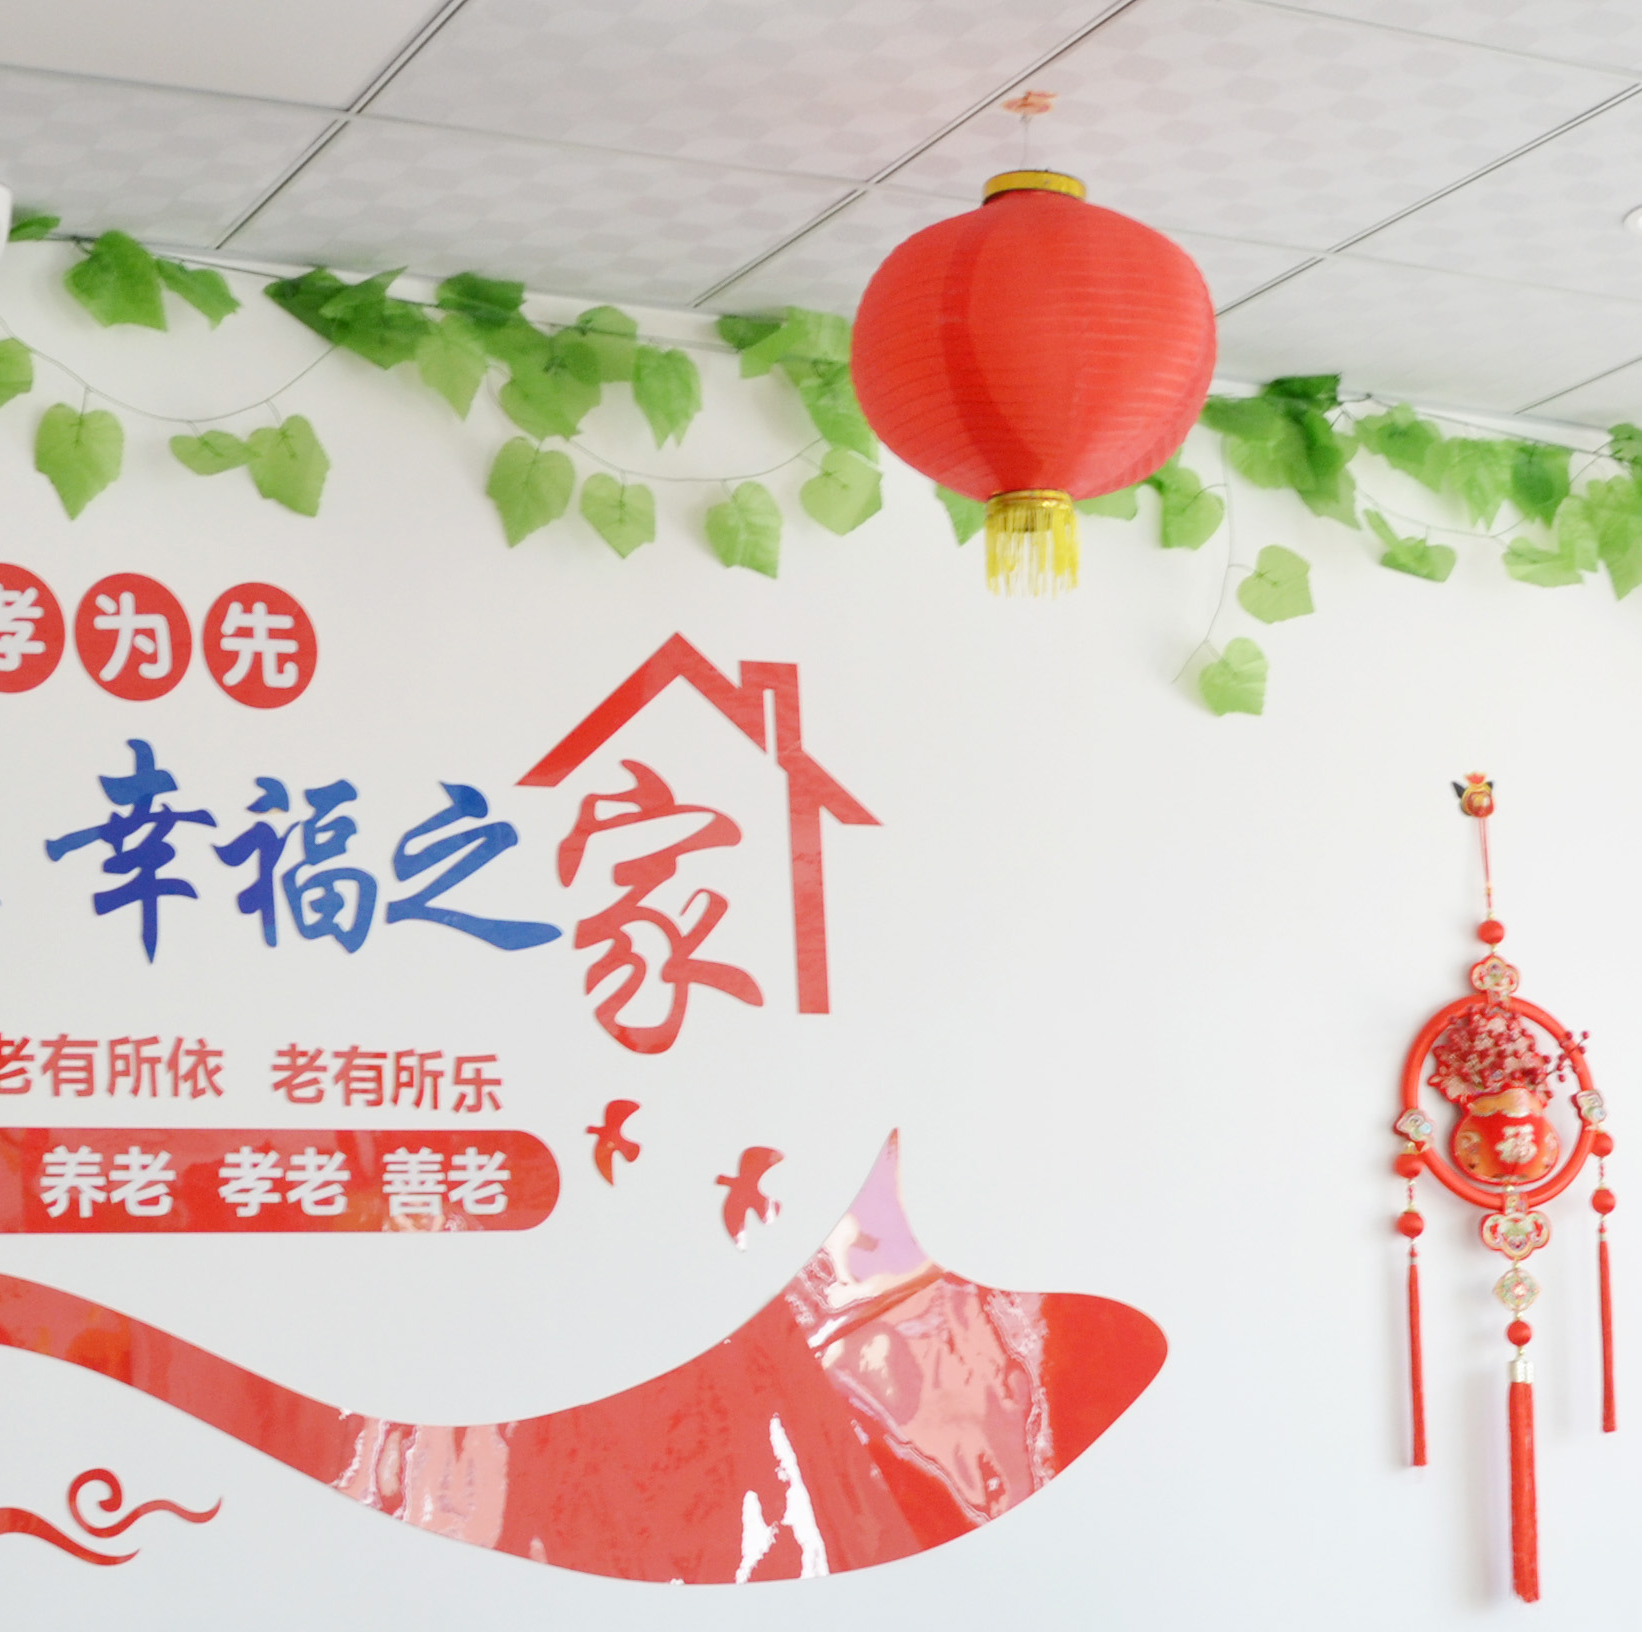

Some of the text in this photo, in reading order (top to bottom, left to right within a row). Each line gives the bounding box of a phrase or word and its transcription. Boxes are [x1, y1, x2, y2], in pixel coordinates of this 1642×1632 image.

[43, 738, 767, 1056] 幸福之家
[271, 1043, 503, 1113] 老有所乐
[1495, 1123, 1537, 1164] 福
[40, 1145, 176, 1218] 养老
[218, 1146, 351, 1218] 孝老
[382, 1147, 511, 1218] 善老
